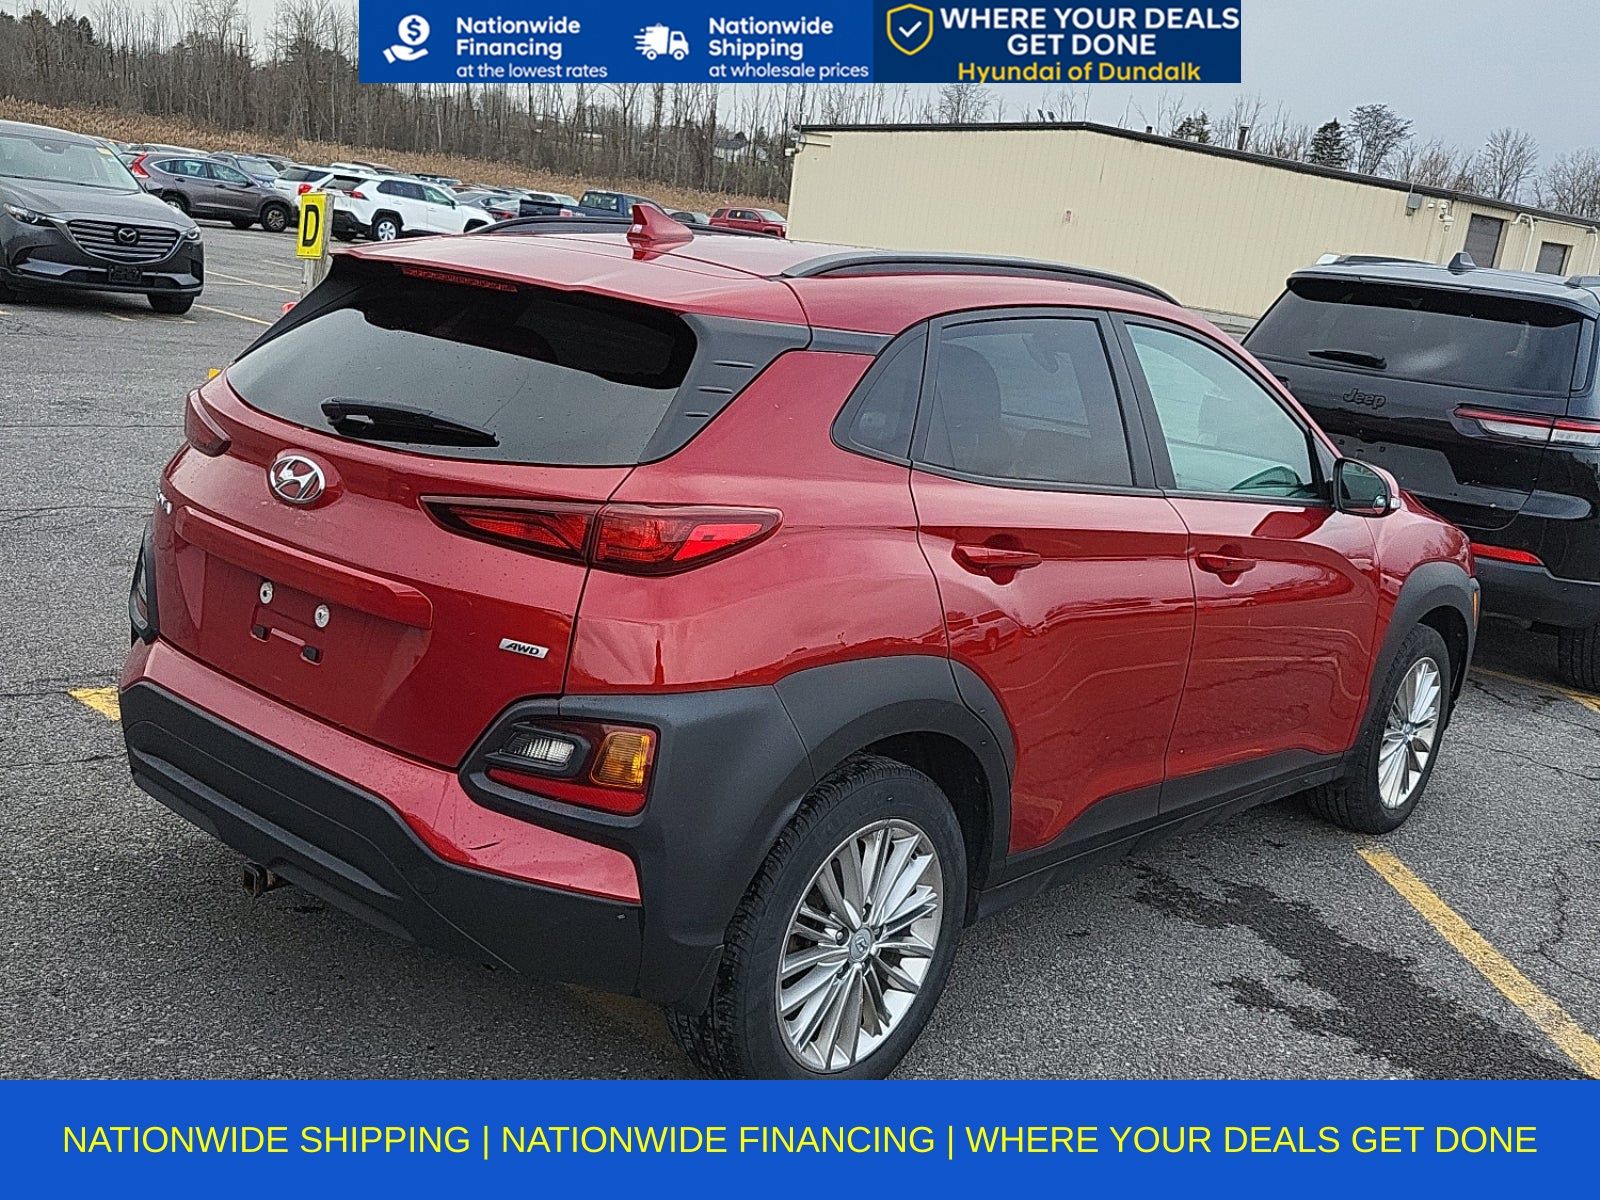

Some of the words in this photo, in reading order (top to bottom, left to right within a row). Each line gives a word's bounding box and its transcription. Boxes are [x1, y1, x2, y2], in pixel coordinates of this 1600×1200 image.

[303, 205, 320, 247] D
[1343, 388, 1387, 410] Jeep
[505, 642, 540, 655] AWD
